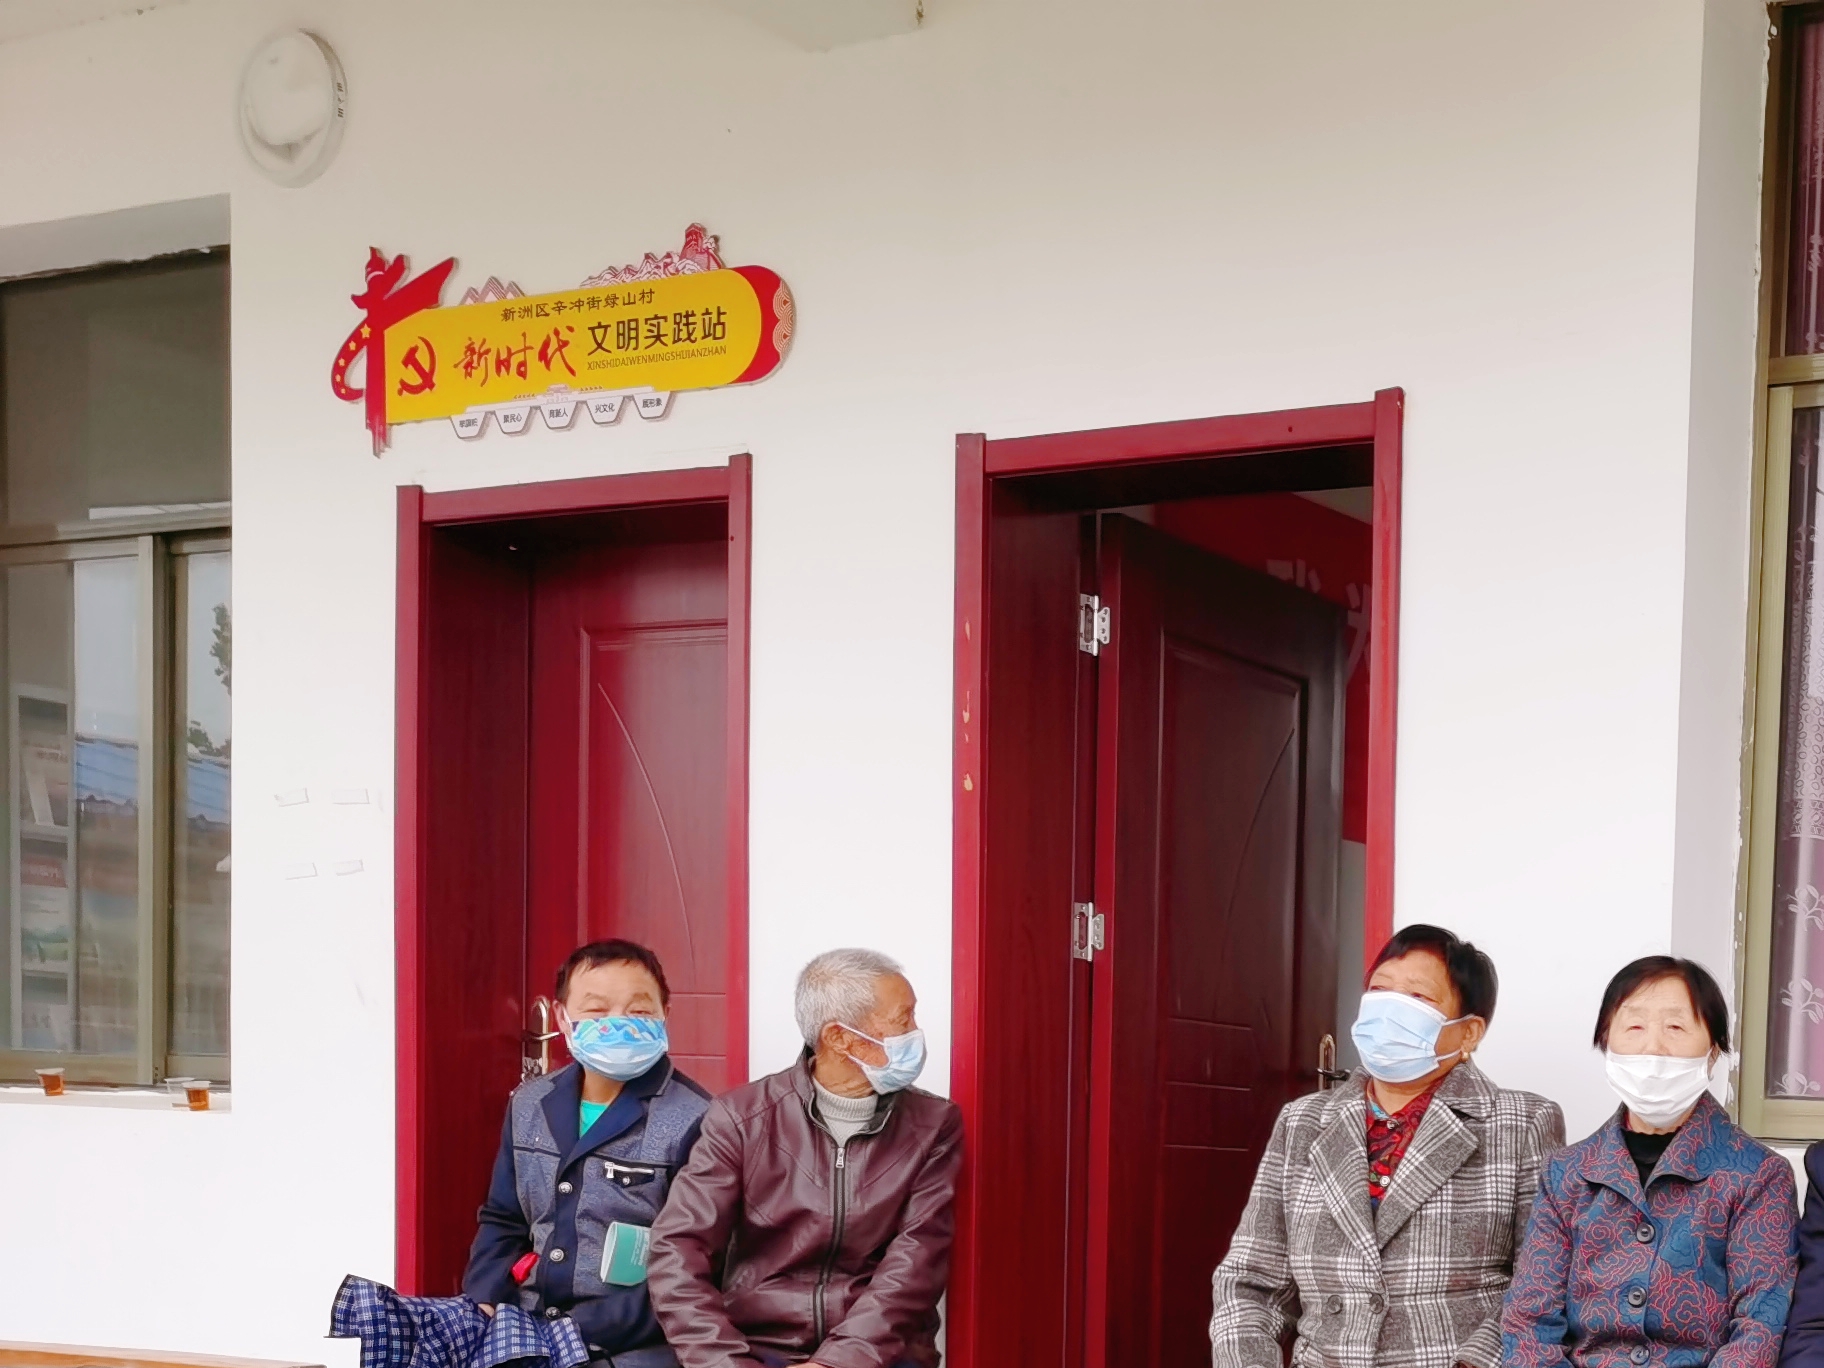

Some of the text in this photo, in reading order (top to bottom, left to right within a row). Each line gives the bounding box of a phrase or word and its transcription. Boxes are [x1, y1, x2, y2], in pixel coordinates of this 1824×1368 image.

[500, 288, 656, 323] 新洲区辛冲街绿山村
[453, 325, 577, 387] 新时代
[587, 306, 728, 356] 文明实践站
